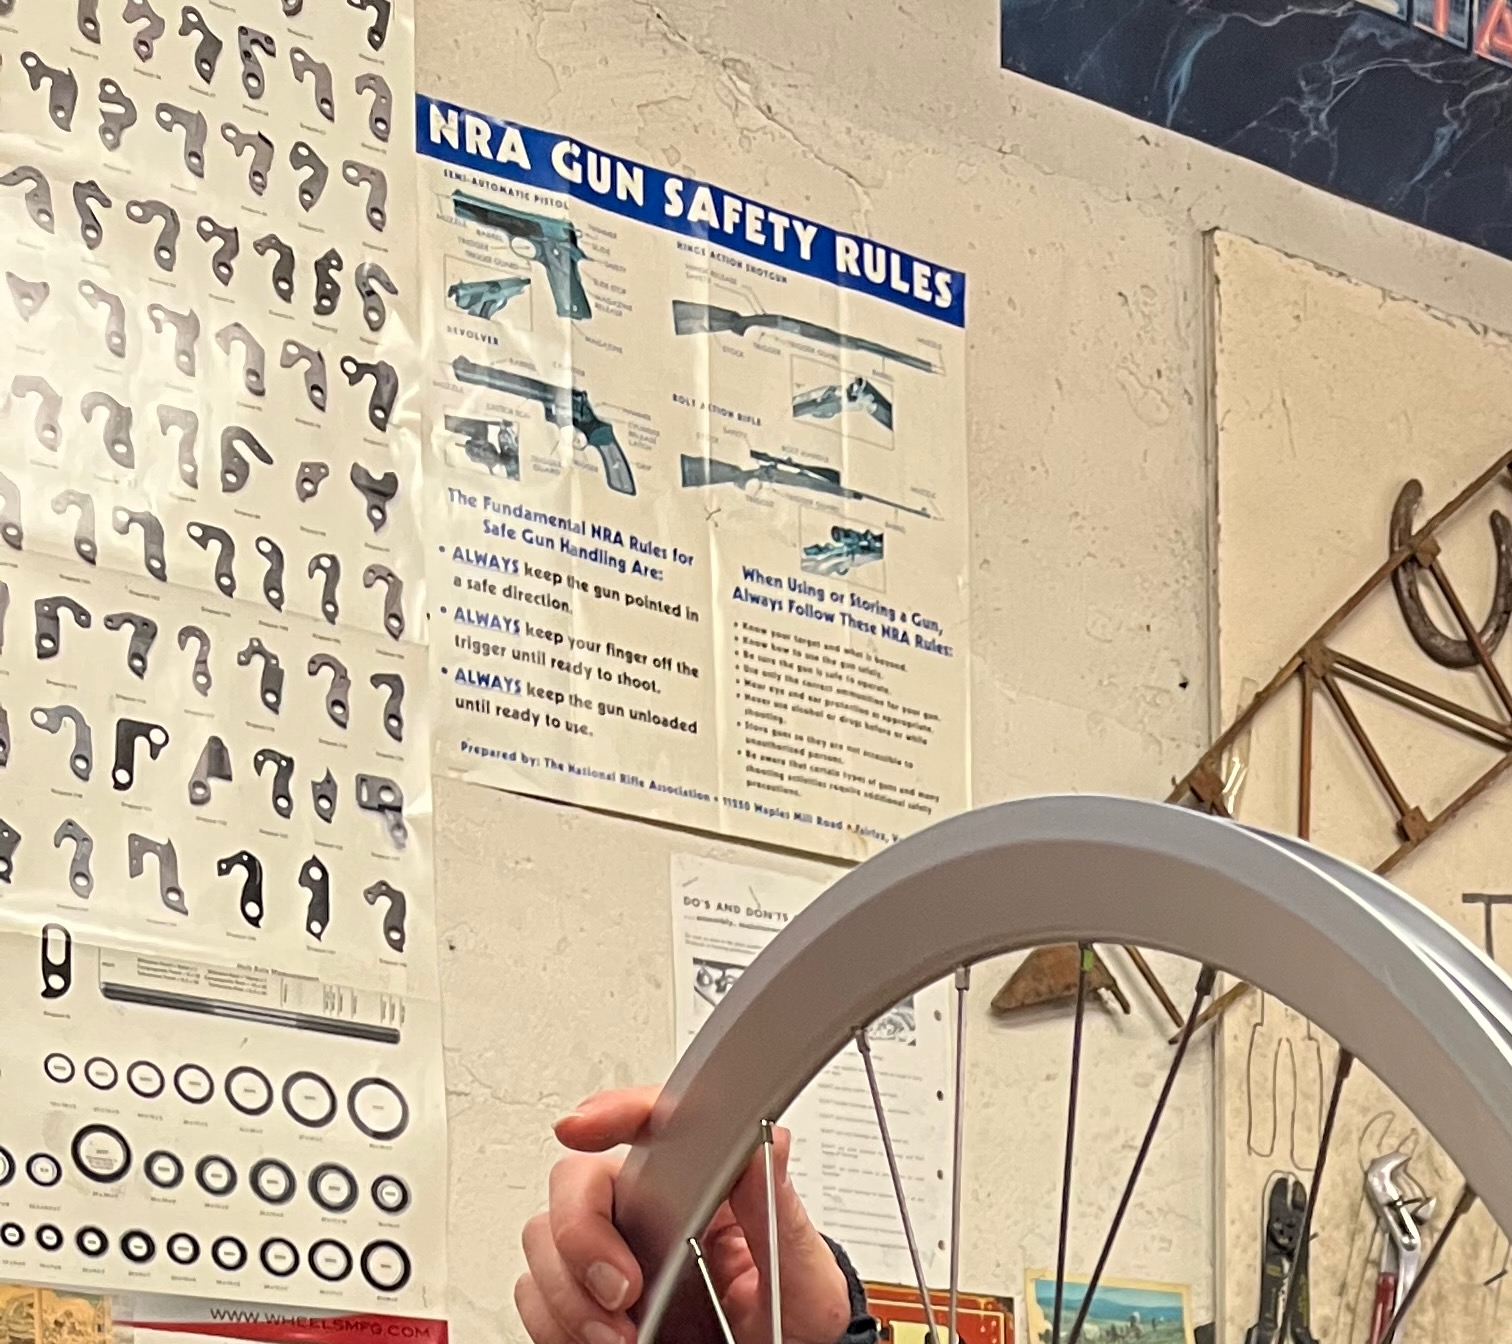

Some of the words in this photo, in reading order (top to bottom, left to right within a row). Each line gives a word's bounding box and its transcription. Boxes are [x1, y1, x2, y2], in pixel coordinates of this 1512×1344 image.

[429, 103, 530, 171] NRA
[551, 140, 645, 207] GUN
[665, 177, 818, 261] SAFETY
[835, 234, 953, 309] RULES
[533, 194, 569, 210] PISTOL
[745, 264, 788, 284] SHOTGUN
[447, 487, 477, 508] The
[482, 495, 586, 536] Fundamental
[591, 523, 624, 548] NRA
[629, 535, 668, 561] Rules
[672, 547, 694, 568] for
[482, 519, 517, 541] Safe
[521, 527, 555, 550] Gun
[560, 537, 627, 574] Handling
[631, 558, 664, 581] Are:
[452, 545, 520, 577] ALWAYS
[524, 561, 563, 586] keep
[566, 573, 590, 593] the
[593, 584, 621, 604] gun
[625, 592, 682, 619] pointed
[685, 604, 700, 623] in
[453, 574, 462, 588] a
[467, 577, 497, 597] safe
[502, 584, 574, 615] direction.
[742, 565, 783, 591] When
[787, 576, 825, 602] Using
[830, 590, 846, 605] or
[849, 592, 896, 622] Storing
[911, 613, 944, 637] Gun,
[454, 605, 521, 635] ALWAYS
[525, 621, 564, 646] keep
[567, 635, 602, 656] your
[605, 641, 649, 669] finger
[652, 655, 672, 674] off
[676, 660, 700, 679] the
[732, 586, 784, 612] Always
[788, 601, 836, 624] Follow
[839, 612, 877, 635] These
[881, 624, 911, 646] NRA
[915, 633, 954, 657] Rules:
[454, 634, 507, 659] trigger
[512, 645, 547, 669] until
[550, 655, 594, 682] ready
[597, 666, 613, 682] to
[616, 671, 662, 695] shoot.
[454, 667, 522, 697] ALWAYS
[526, 681, 565, 706] keep
[568, 692, 594, 711] the
[597, 702, 625, 719] gun
[629, 706, 699, 735] unloaded
[455, 695, 491, 715] until
[496, 705, 540, 728] ready
[545, 714, 561, 729] to
[565, 719, 594, 737] use.
[460, 740, 517, 764] Prepared
[544, 756, 564, 773] The
[620, 772, 645, 789] Rifle
[650, 779, 711, 803] Association
[816, 815, 843, 832] Road
[716, 902, 741, 915] AND
